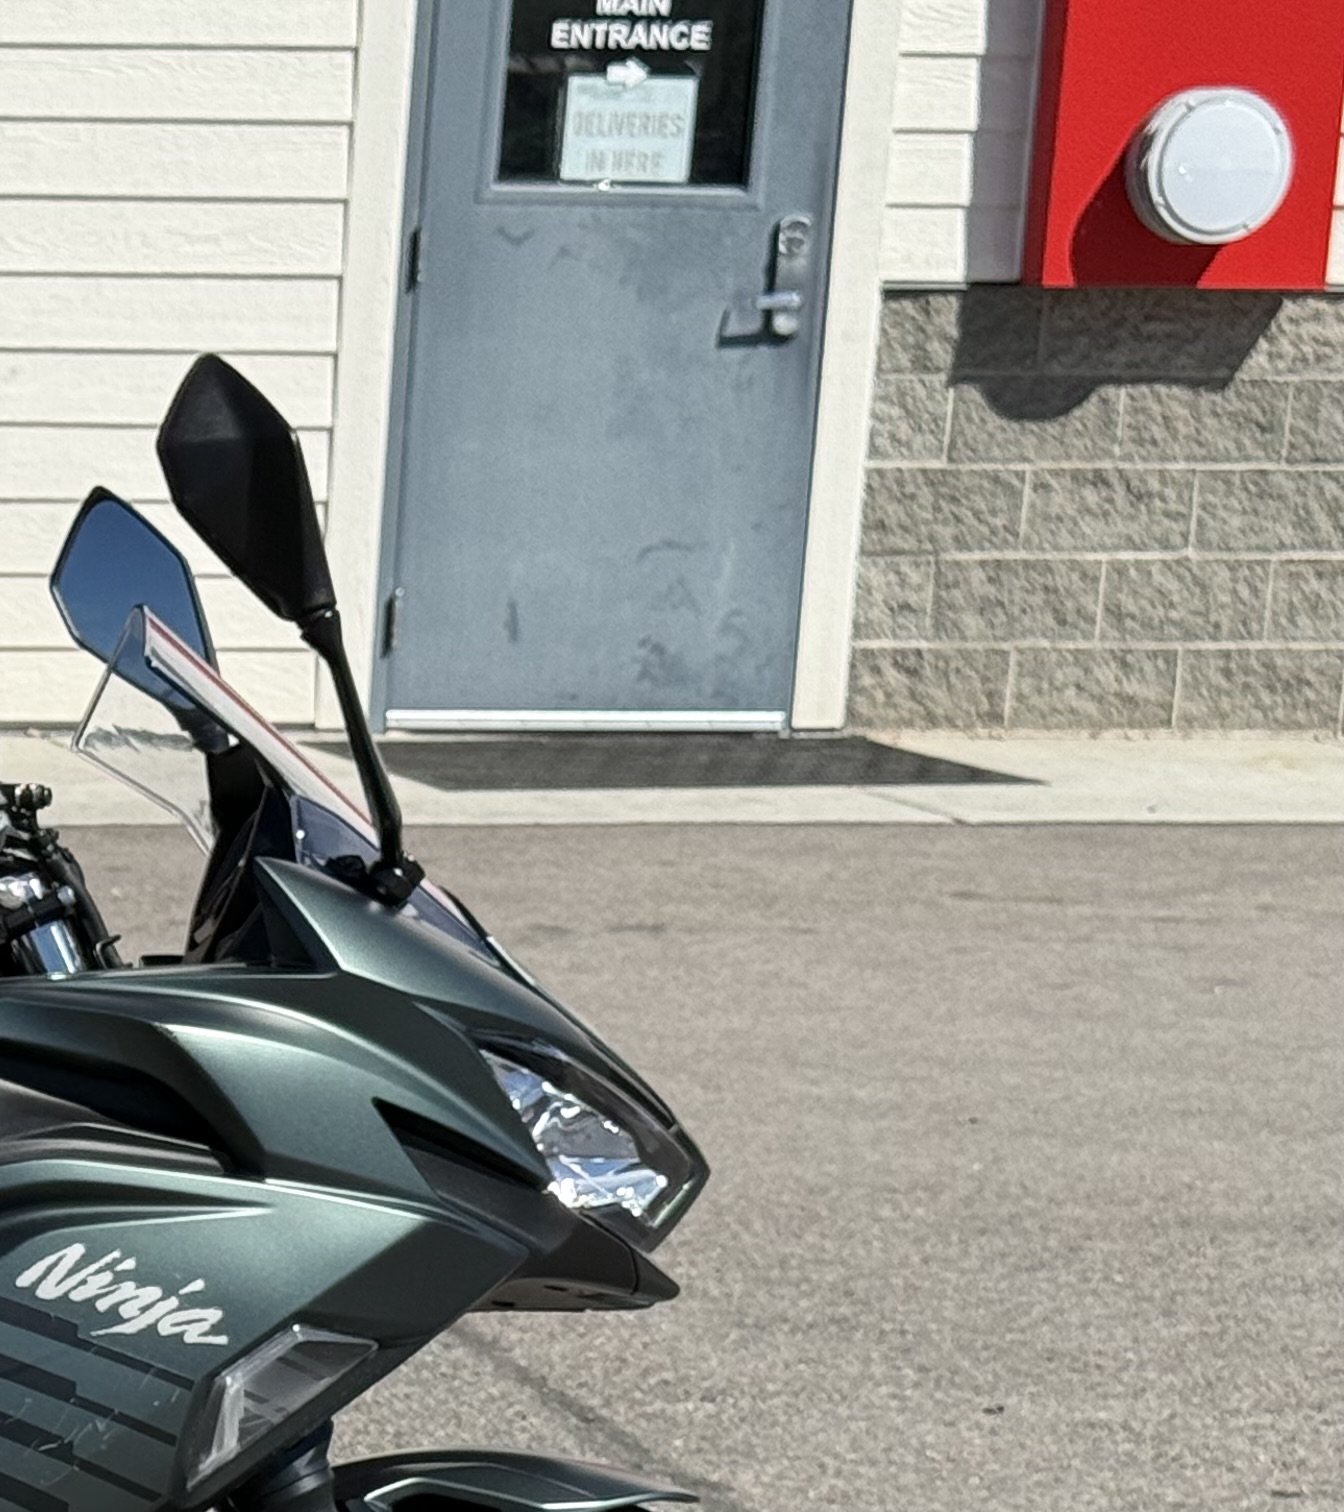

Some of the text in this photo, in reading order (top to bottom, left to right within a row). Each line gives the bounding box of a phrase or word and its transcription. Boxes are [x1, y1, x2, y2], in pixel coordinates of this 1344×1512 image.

[551, 20, 712, 50] ENTRANCE
[572, 109, 685, 139] DELIVERIES
[585, 149, 606, 172] IN
[15, 1242, 229, 1345] Ninja
